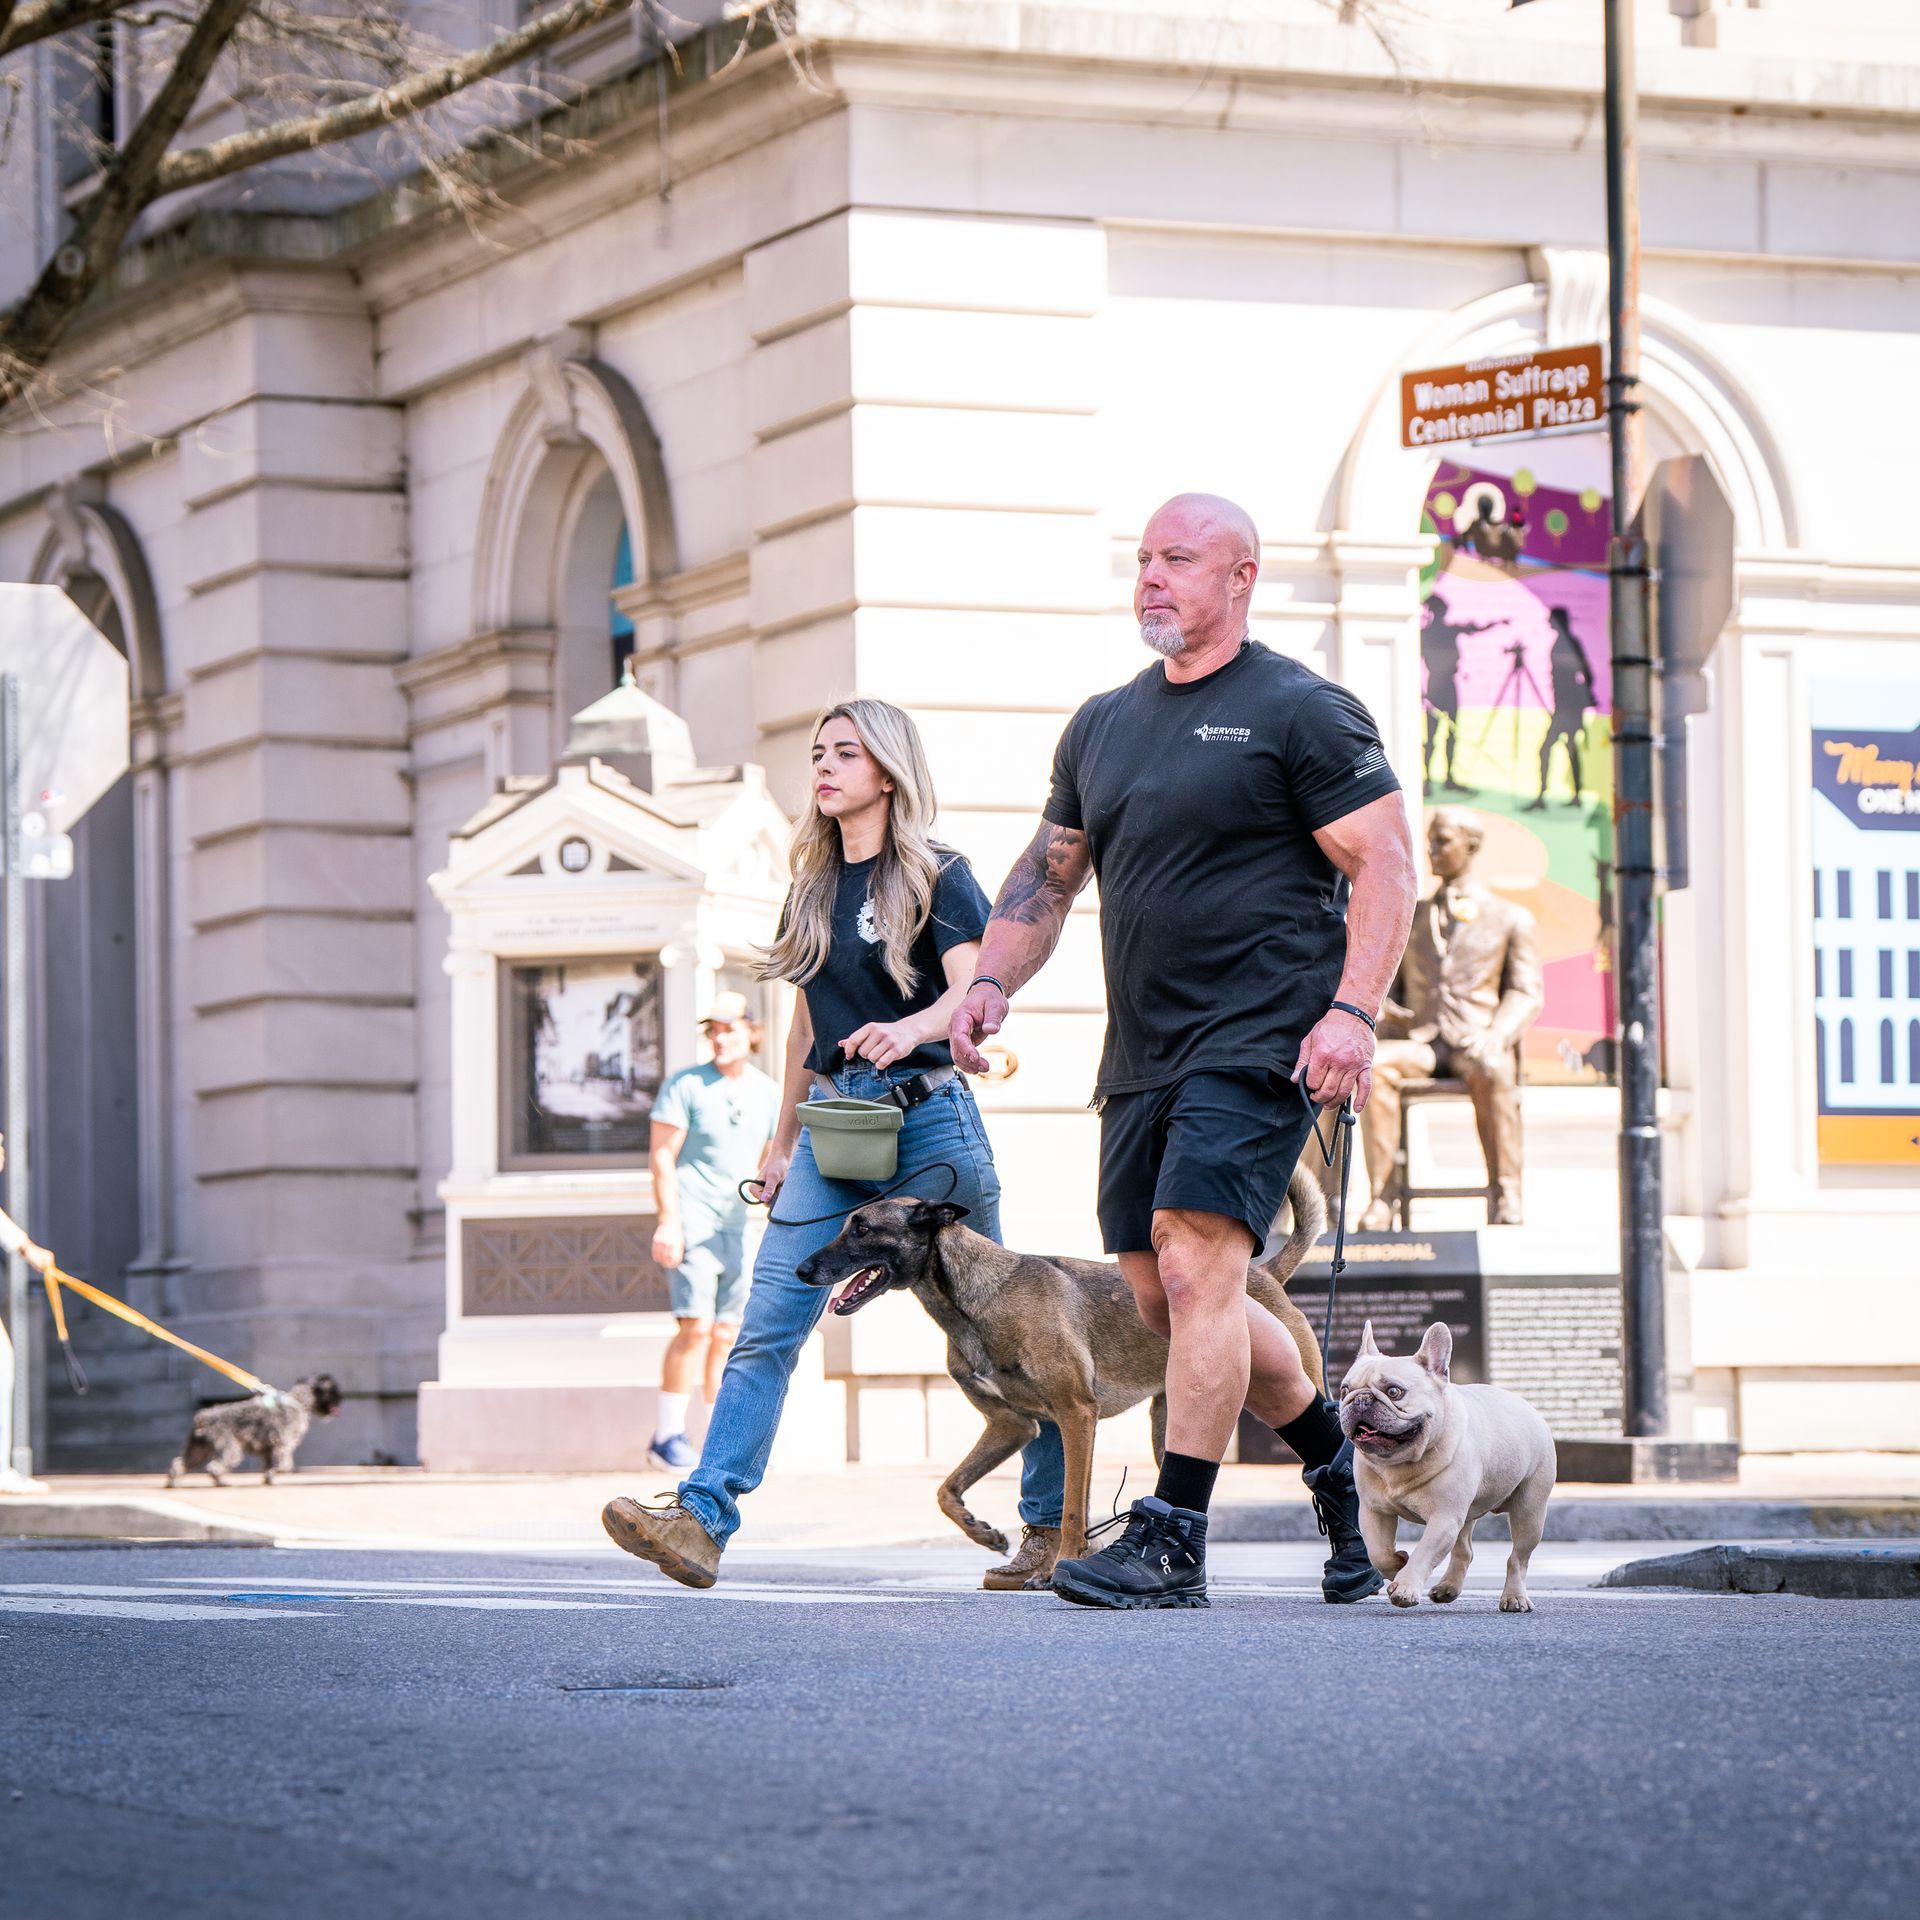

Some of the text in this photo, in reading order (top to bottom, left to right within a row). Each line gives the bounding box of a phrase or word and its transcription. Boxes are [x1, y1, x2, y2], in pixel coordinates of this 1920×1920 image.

[1413, 364, 1590, 412] Woman Suffrage
[1409, 396, 1596, 445] Centennial Plaza
[1205, 734, 1249, 743] Unlimited
[1207, 726, 1251, 736] SERVICES
[1823, 739, 1914, 796] Many
[1857, 787, 1904, 815] ONE
